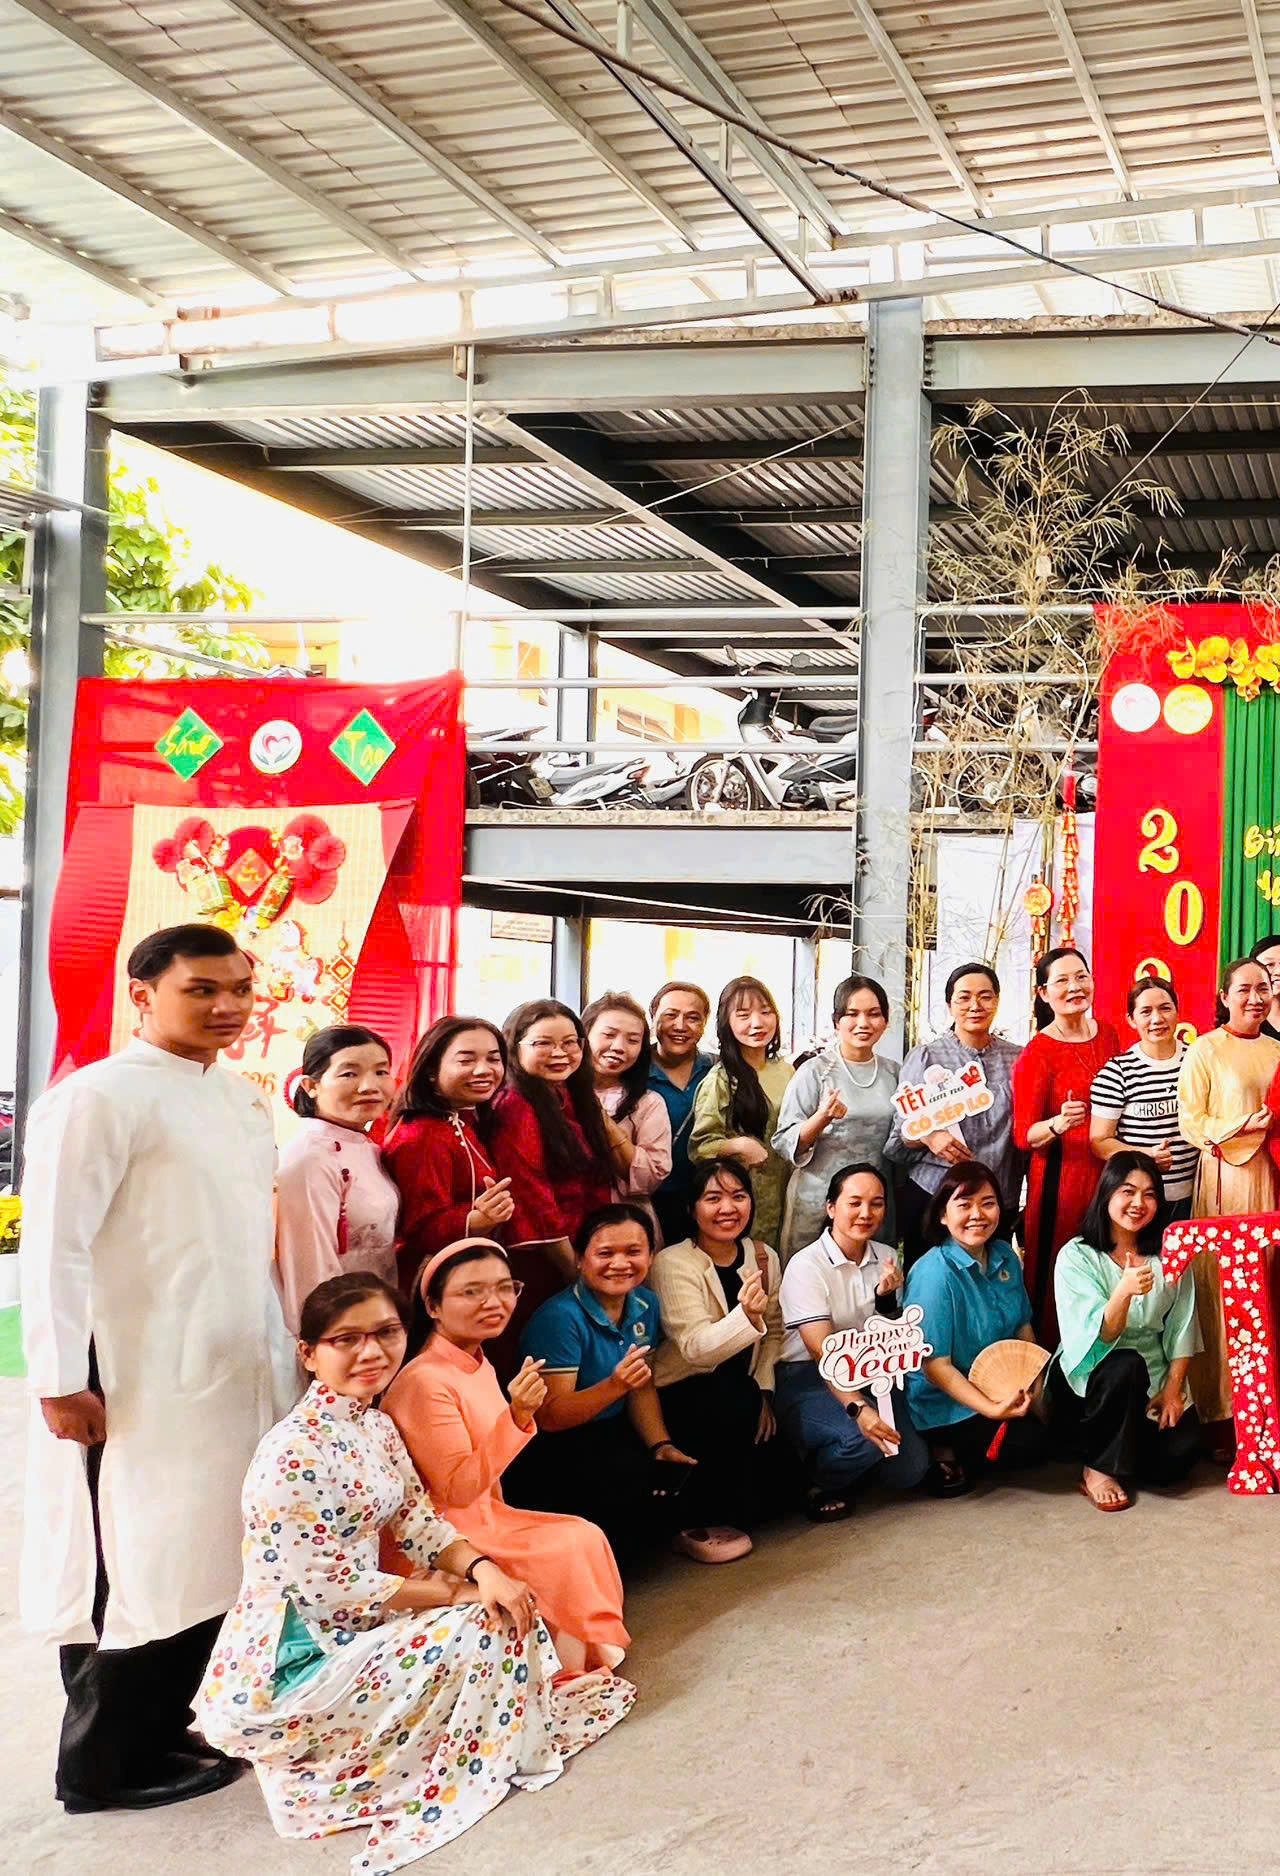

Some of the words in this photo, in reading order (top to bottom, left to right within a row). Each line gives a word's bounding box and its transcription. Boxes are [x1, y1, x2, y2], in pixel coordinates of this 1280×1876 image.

[896, 1085, 926, 1114] TẾT
[824, 1326, 905, 1356] Happy
[876, 1340, 910, 1356] New
[834, 1345, 930, 1383] Year
